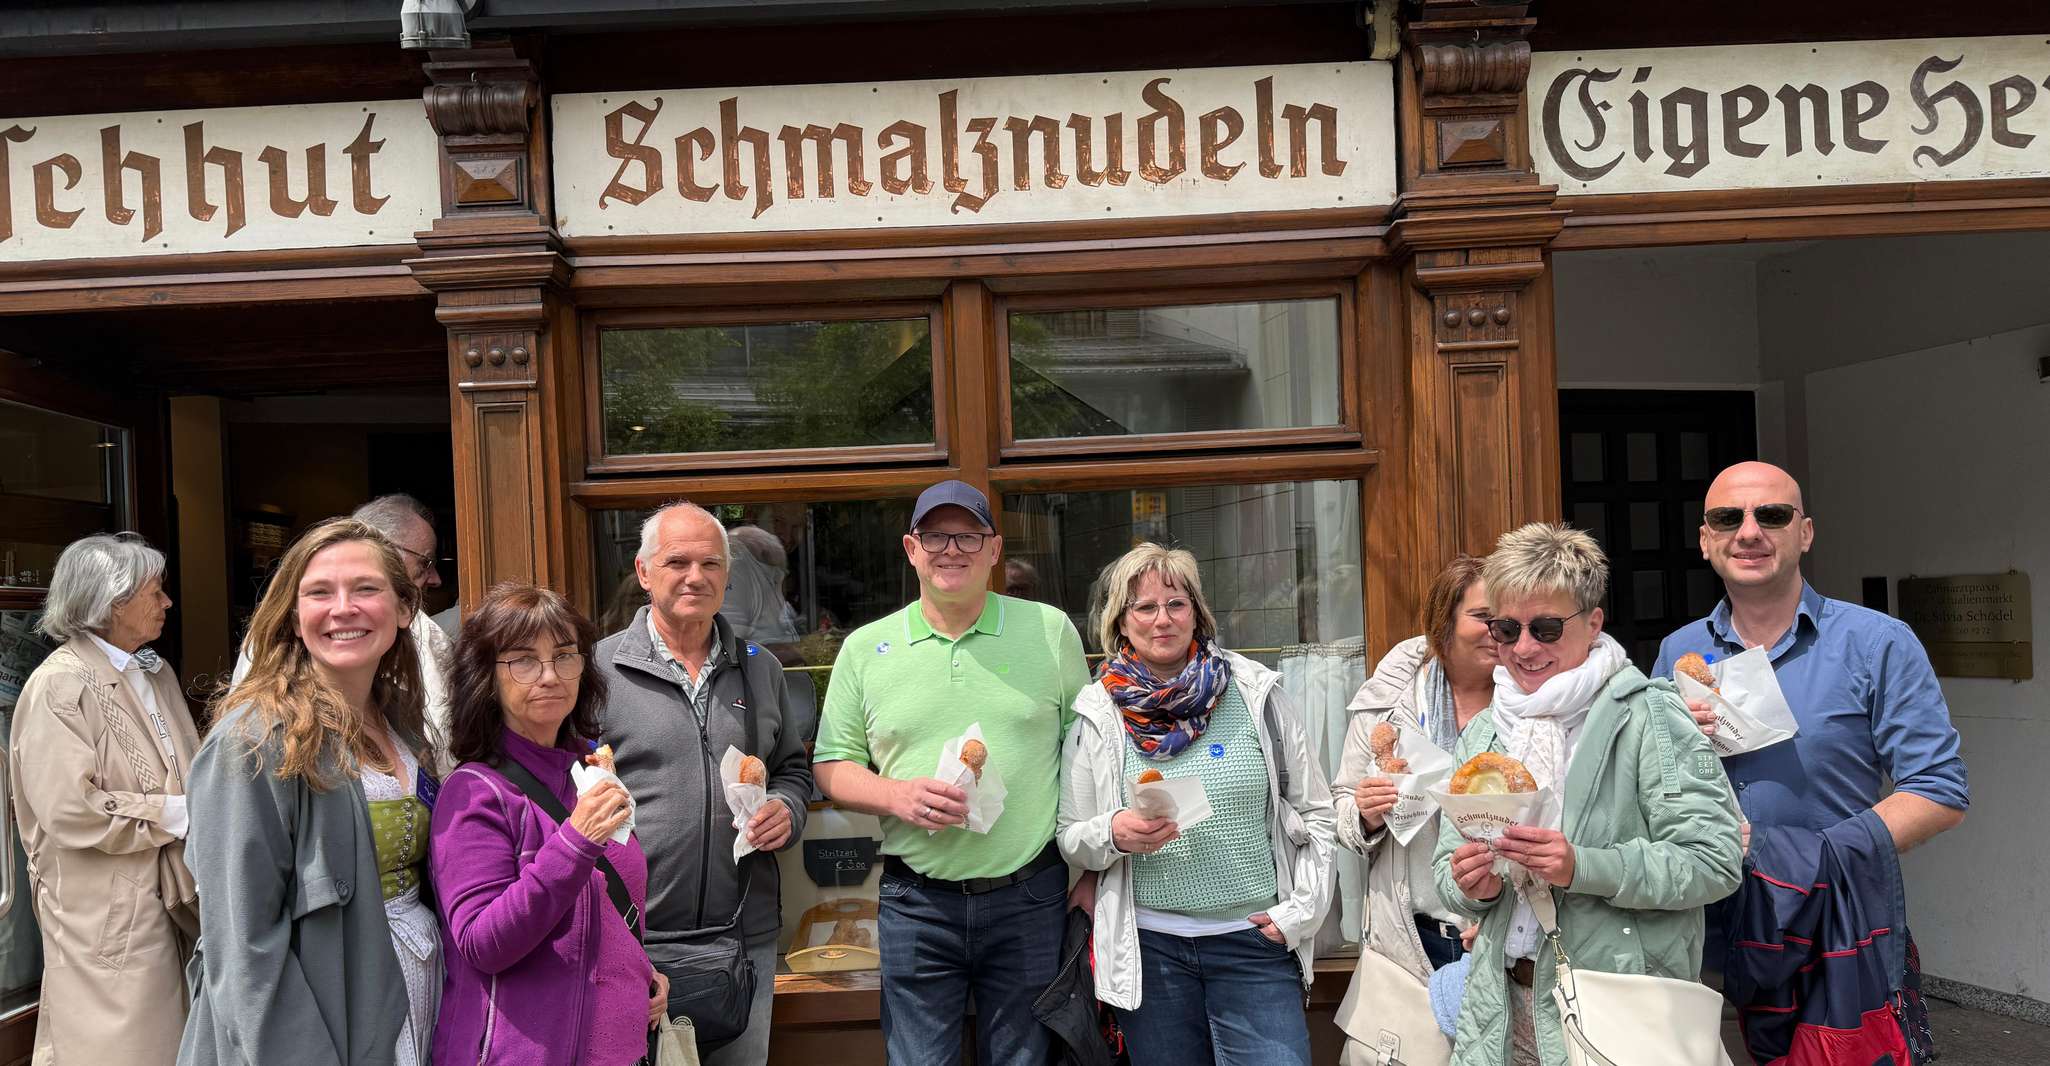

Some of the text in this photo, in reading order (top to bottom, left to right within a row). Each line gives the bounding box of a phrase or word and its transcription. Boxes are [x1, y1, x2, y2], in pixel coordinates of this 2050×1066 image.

[600, 76, 1348, 220] Schmalznudeln
[1542, 54, 2050, 181] Eigene He
